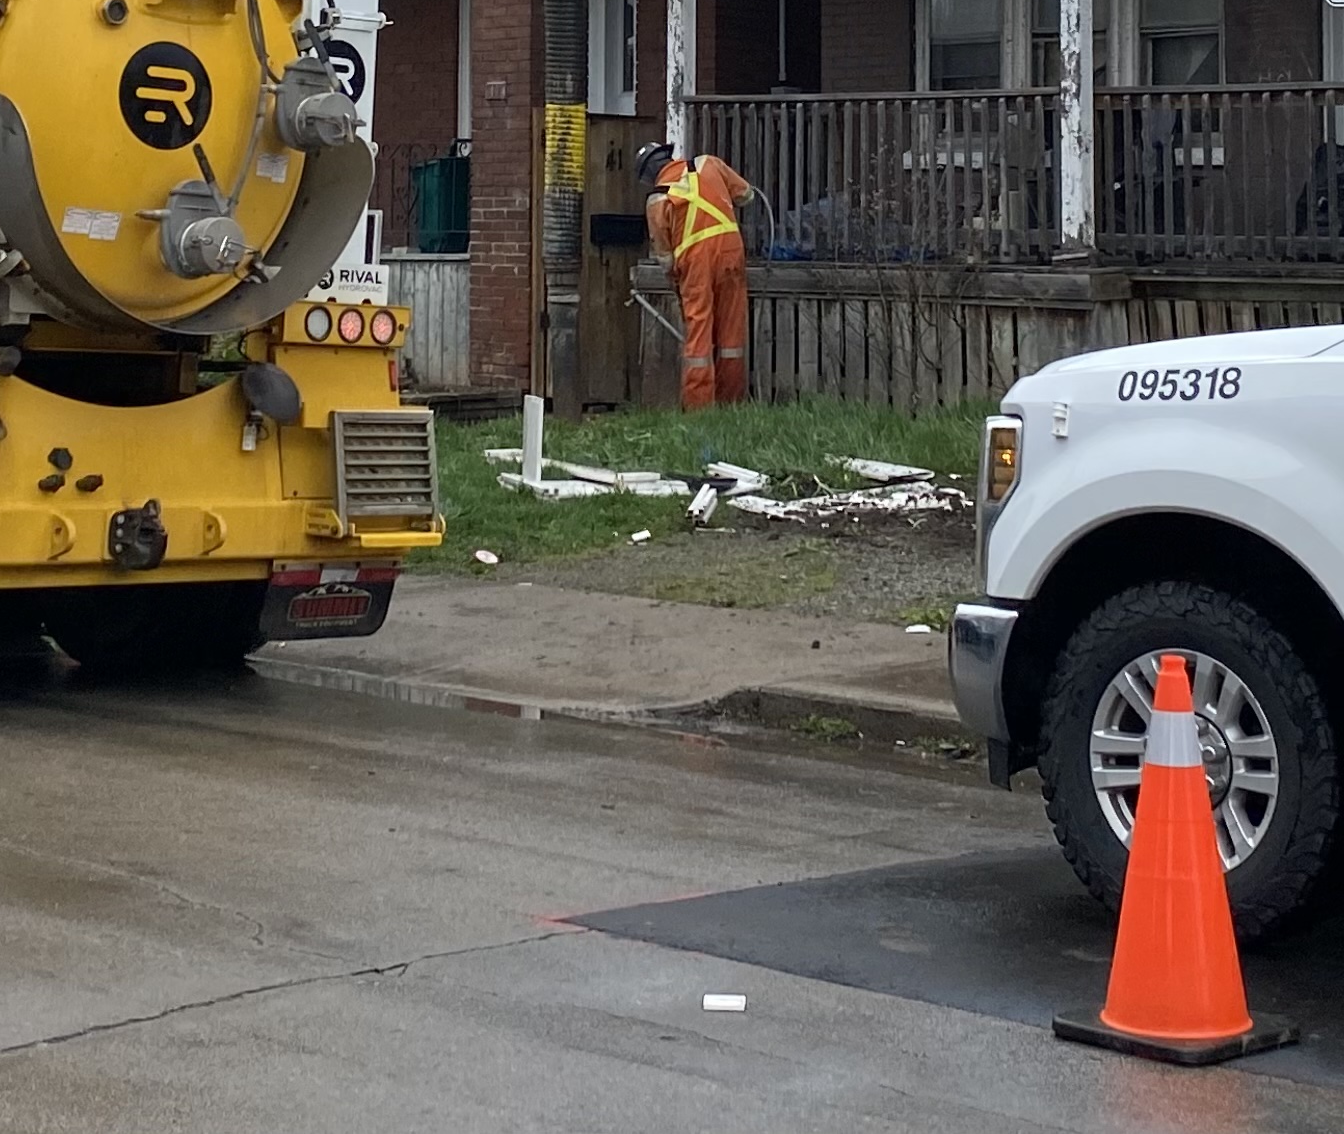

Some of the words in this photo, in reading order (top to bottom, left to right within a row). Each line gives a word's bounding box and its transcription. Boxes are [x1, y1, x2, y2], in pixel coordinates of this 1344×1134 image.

[339, 269, 382, 284] RIVAL
[338, 285, 383, 293] HYDROVAC
[1118, 367, 1242, 401] 095318
